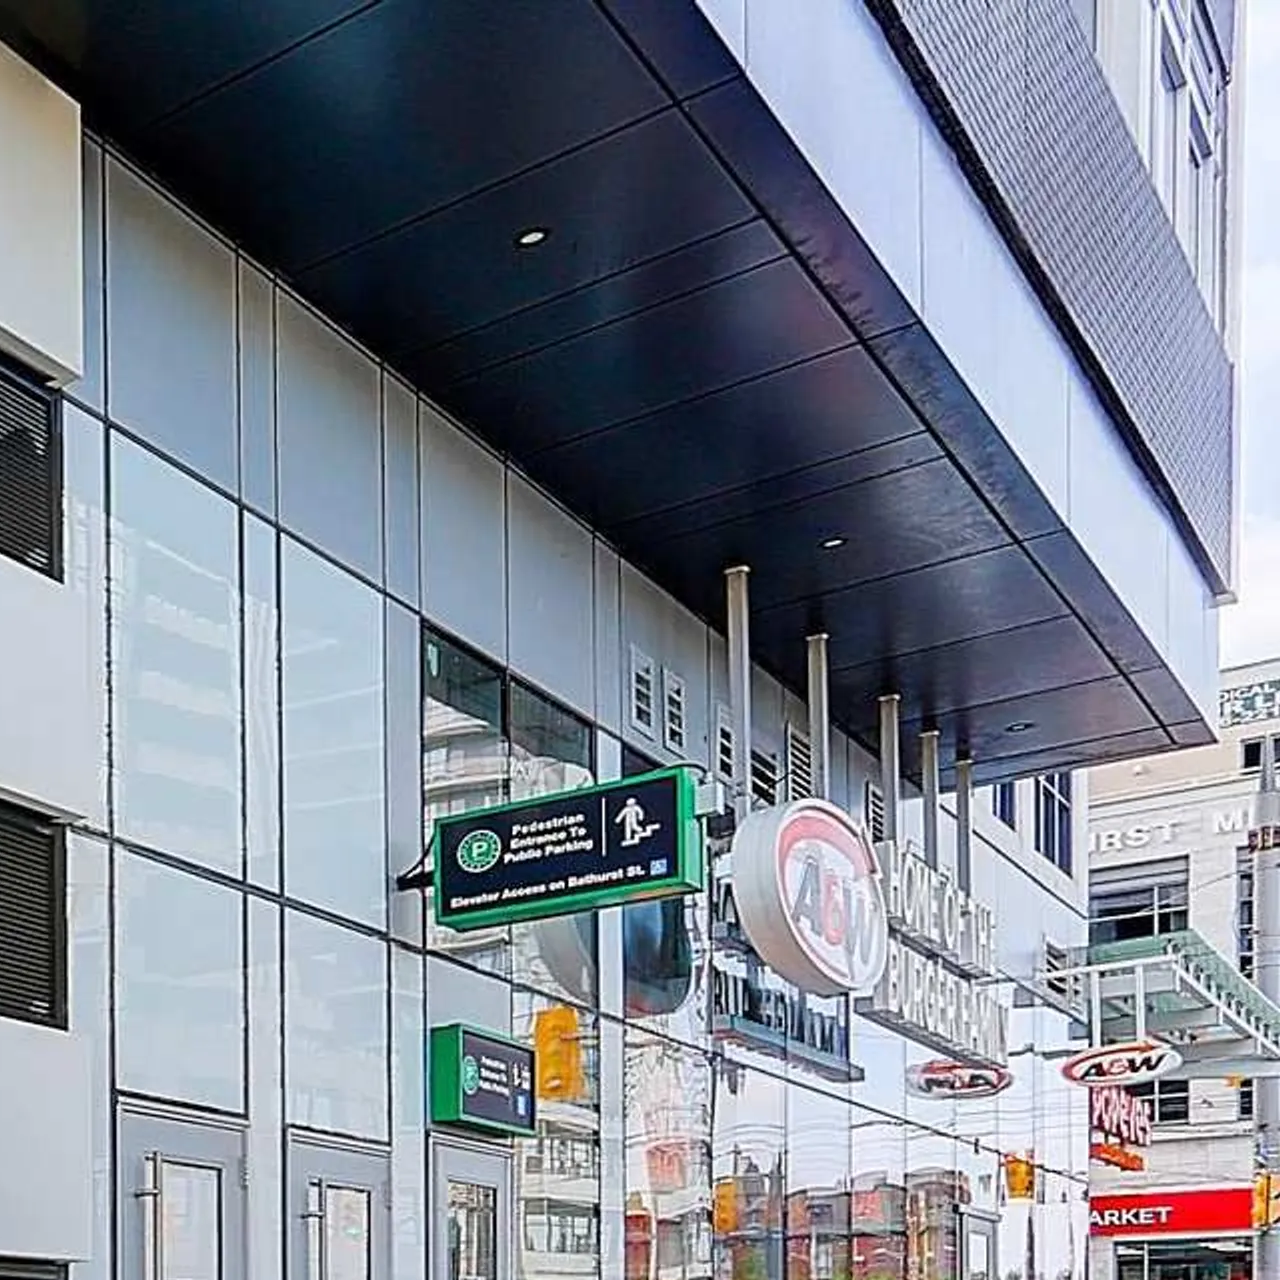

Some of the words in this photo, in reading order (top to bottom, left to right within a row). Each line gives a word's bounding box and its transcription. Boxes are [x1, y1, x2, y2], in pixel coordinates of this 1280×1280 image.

[512, 814, 586, 836] Pedestrian
[510, 831, 567, 849] Entrance
[570, 826, 587, 838] To
[504, 848, 543, 864] Public
[544, 839, 594, 856] Parking
[450, 892, 500, 908] Elevator
[501, 883, 547, 900] Access
[548, 880, 566, 892] on
[567, 868, 625, 888] Bathurst
[1081, 1054, 1168, 1080] A&W
[1090, 1206, 1174, 1226] ARKET
